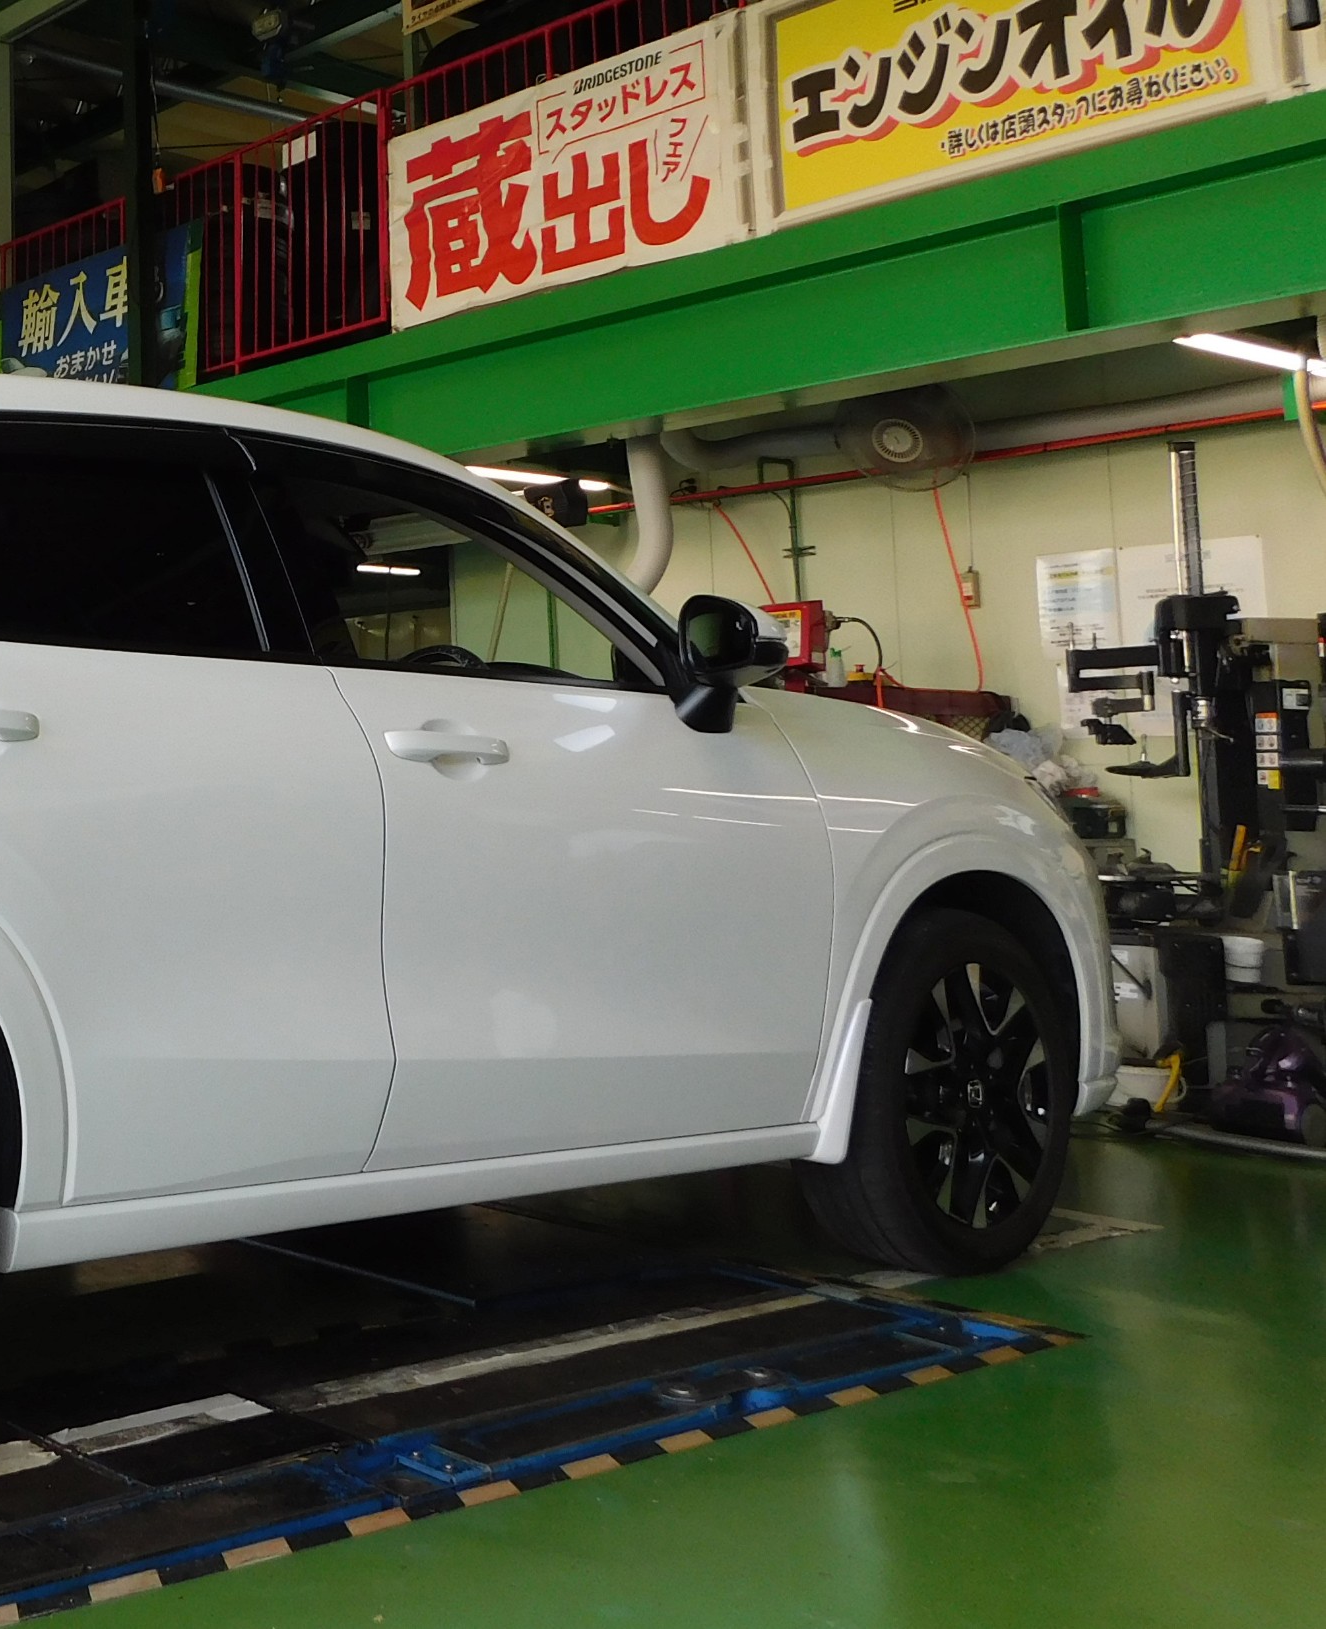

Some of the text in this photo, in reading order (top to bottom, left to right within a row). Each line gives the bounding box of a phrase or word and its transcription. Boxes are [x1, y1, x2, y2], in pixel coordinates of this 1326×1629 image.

[545, 62, 697, 141] スタッドレス
[573, 51, 663, 95] BRIDGESTONE
[661, 117, 688, 183] フェア
[403, 110, 711, 312] 蔵出し
[54, 340, 117, 378] おまかせ
